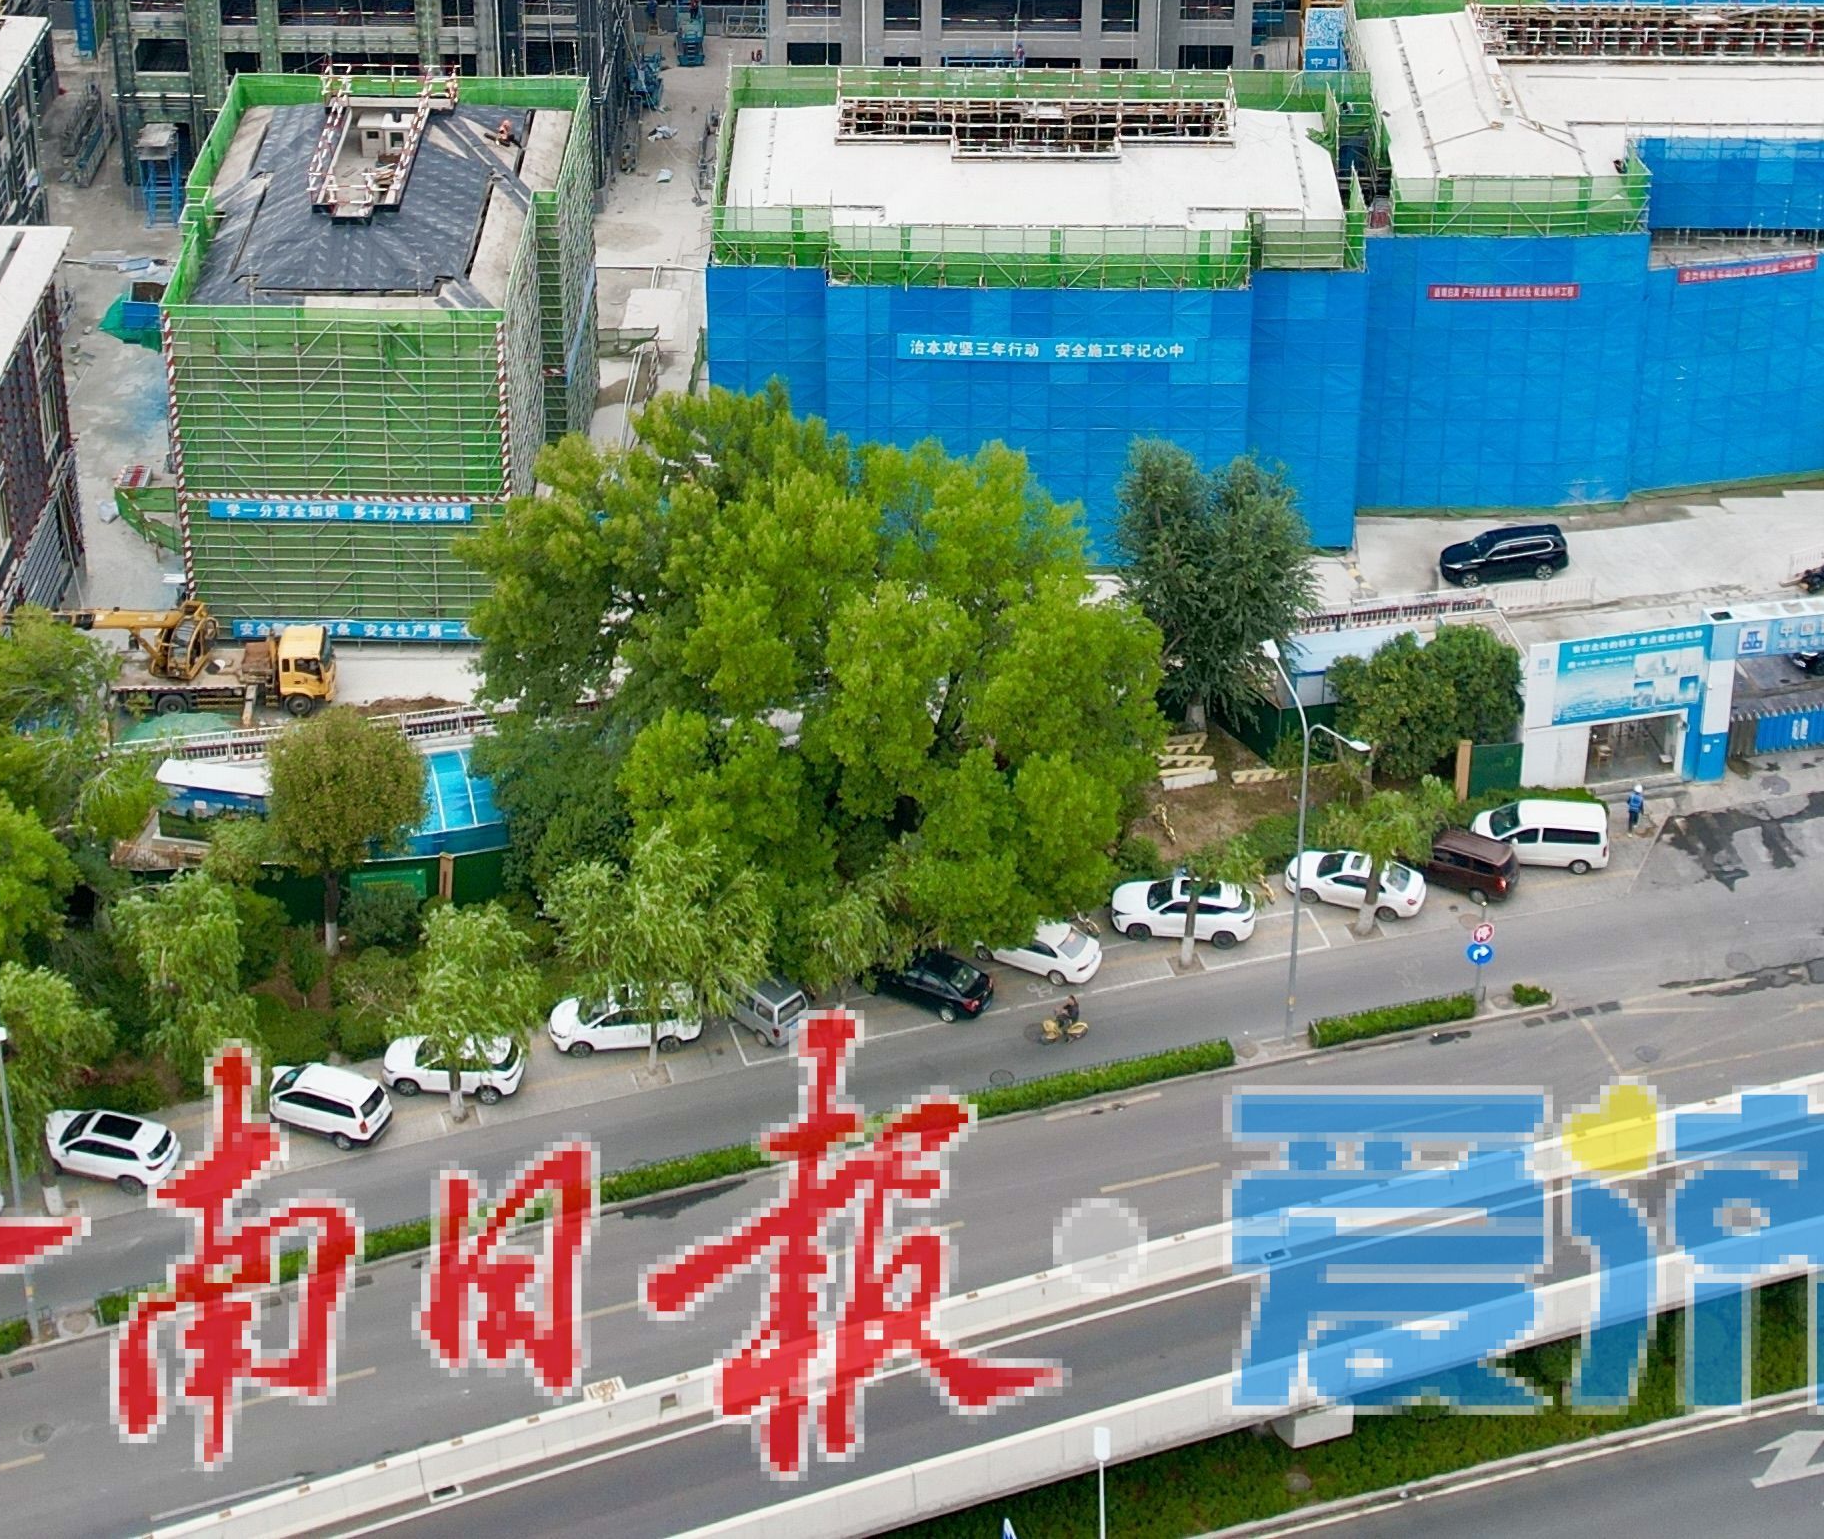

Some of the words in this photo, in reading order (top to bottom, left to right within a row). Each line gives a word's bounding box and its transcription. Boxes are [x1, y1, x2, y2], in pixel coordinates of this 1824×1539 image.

[909, 338, 1040, 358] 治本攻坚三年行动
[1054, 341, 1185, 360] 安全施工牢记心中
[226, 503, 340, 519] 学一分安全知识
[352, 504, 466, 521] 多十分平安保障
